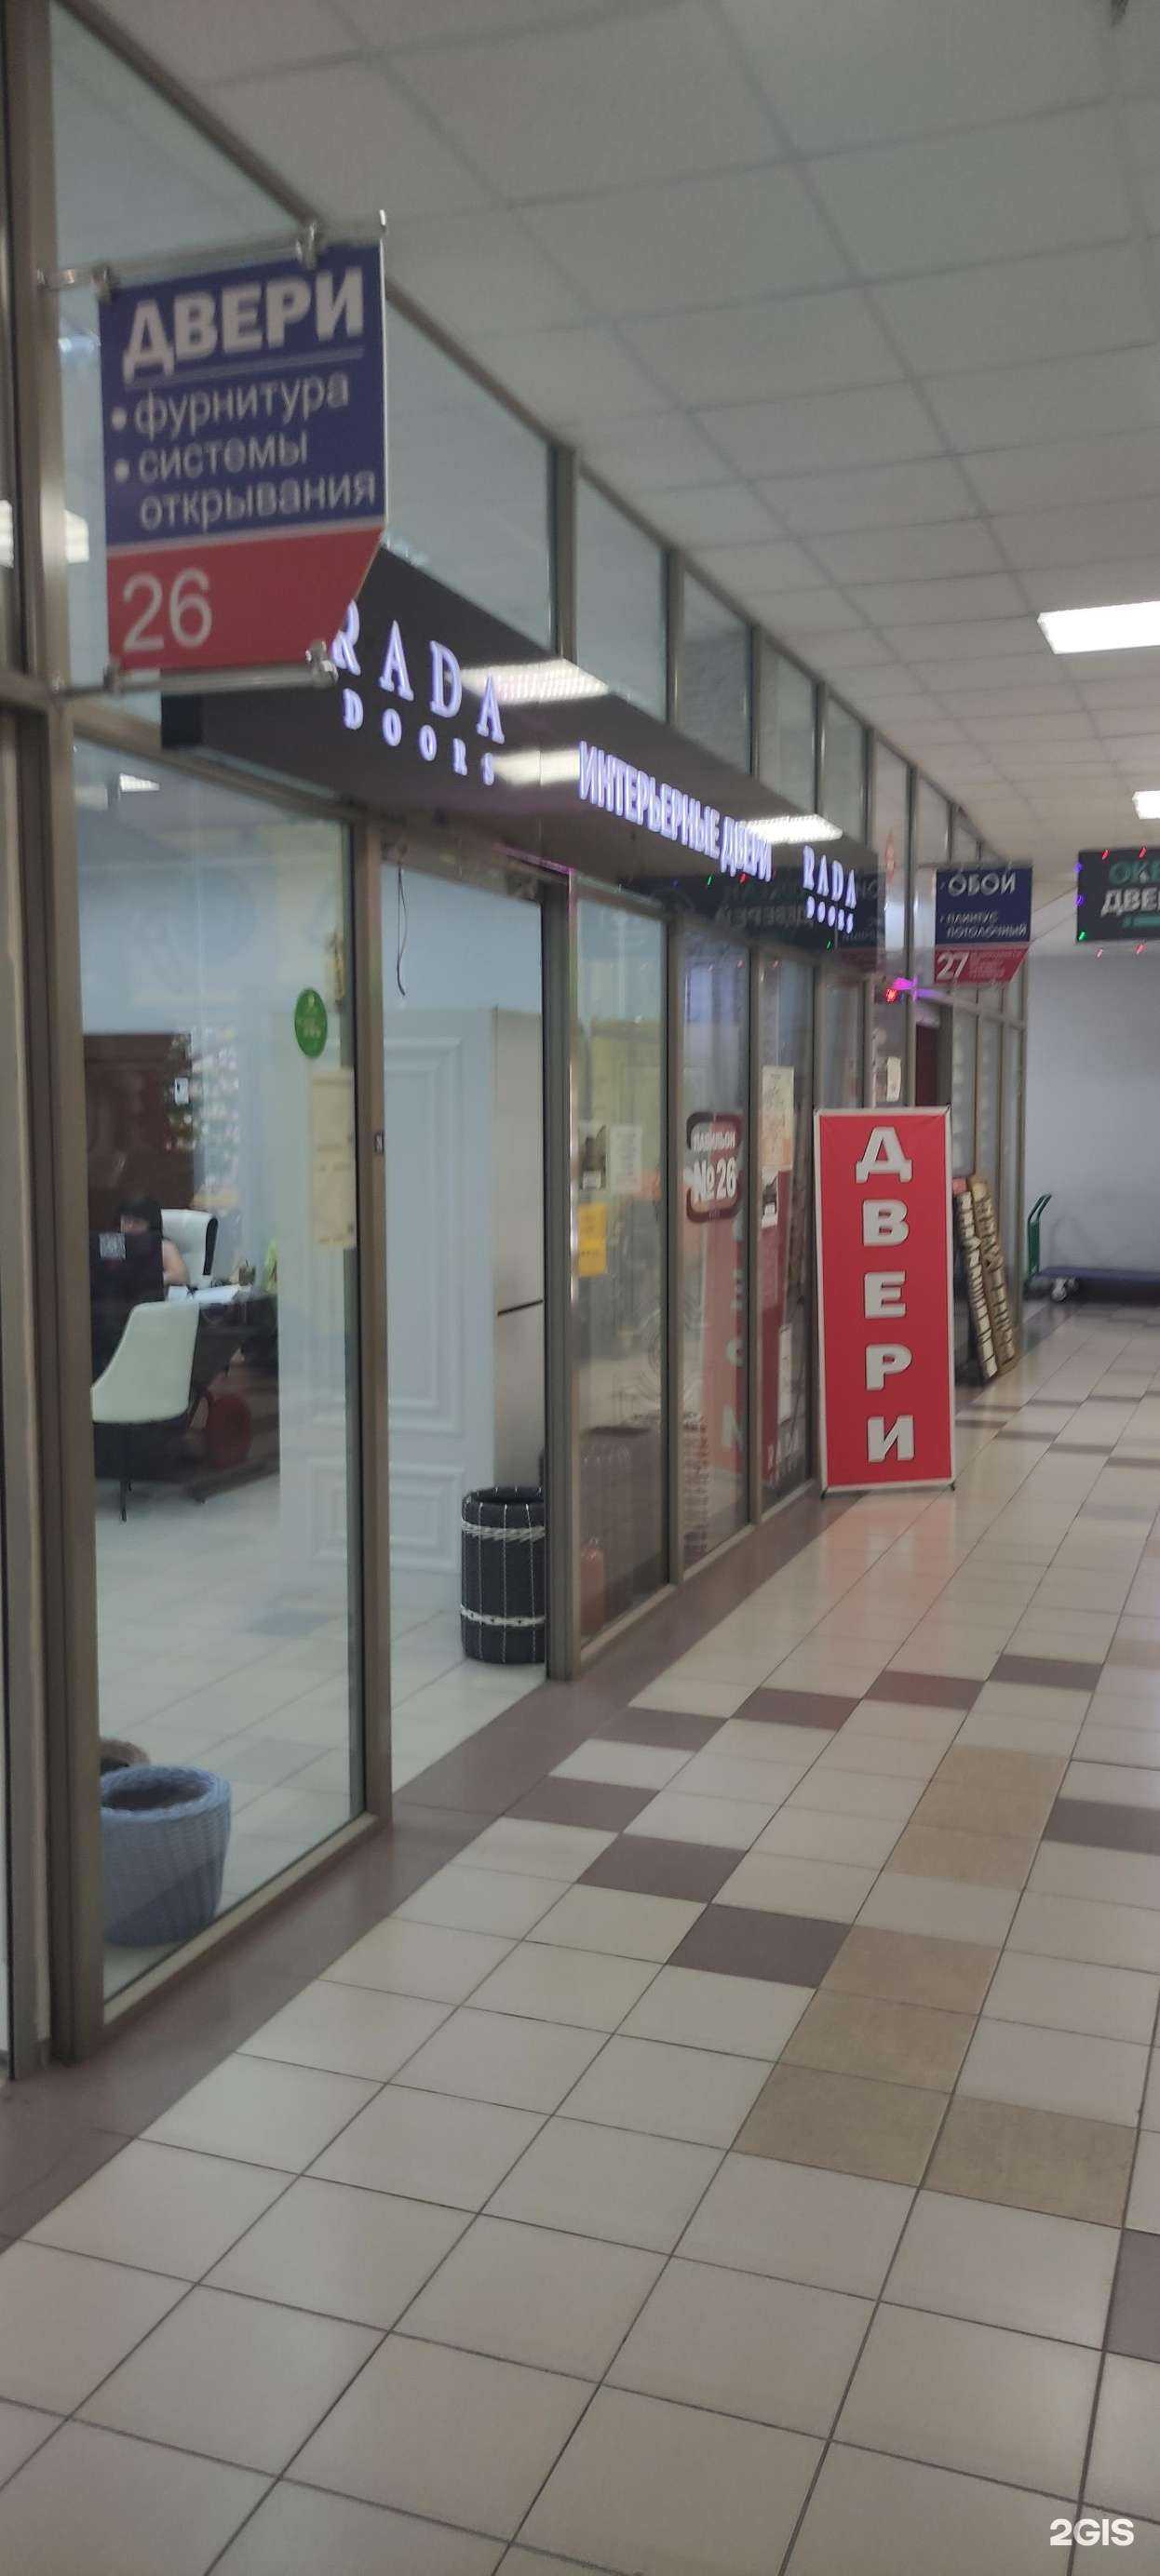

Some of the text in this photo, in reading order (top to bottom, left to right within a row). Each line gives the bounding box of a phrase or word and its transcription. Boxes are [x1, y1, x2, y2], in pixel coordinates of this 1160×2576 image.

[123, 266, 364, 384] ДВЕРИ
[135, 372, 350, 441] фурнитура
[140, 430, 307, 484] системы
[141, 469, 376, 532] открывания
[122, 568, 213, 651] 26
[331, 599, 505, 745] RADA
[343, 688, 495, 786] DOORS
[579, 741, 772, 882] ИНТЕРЬЕРНЫЕ ДВЕРИ
[803, 845, 857, 910] RADA
[948, 872, 1017, 896] ОБОИ
[1100, 887, 1160, 919] ДВЕ
[936, 951, 969, 983] 27
[855, 1126, 916, 1463] ДВЕРИ
